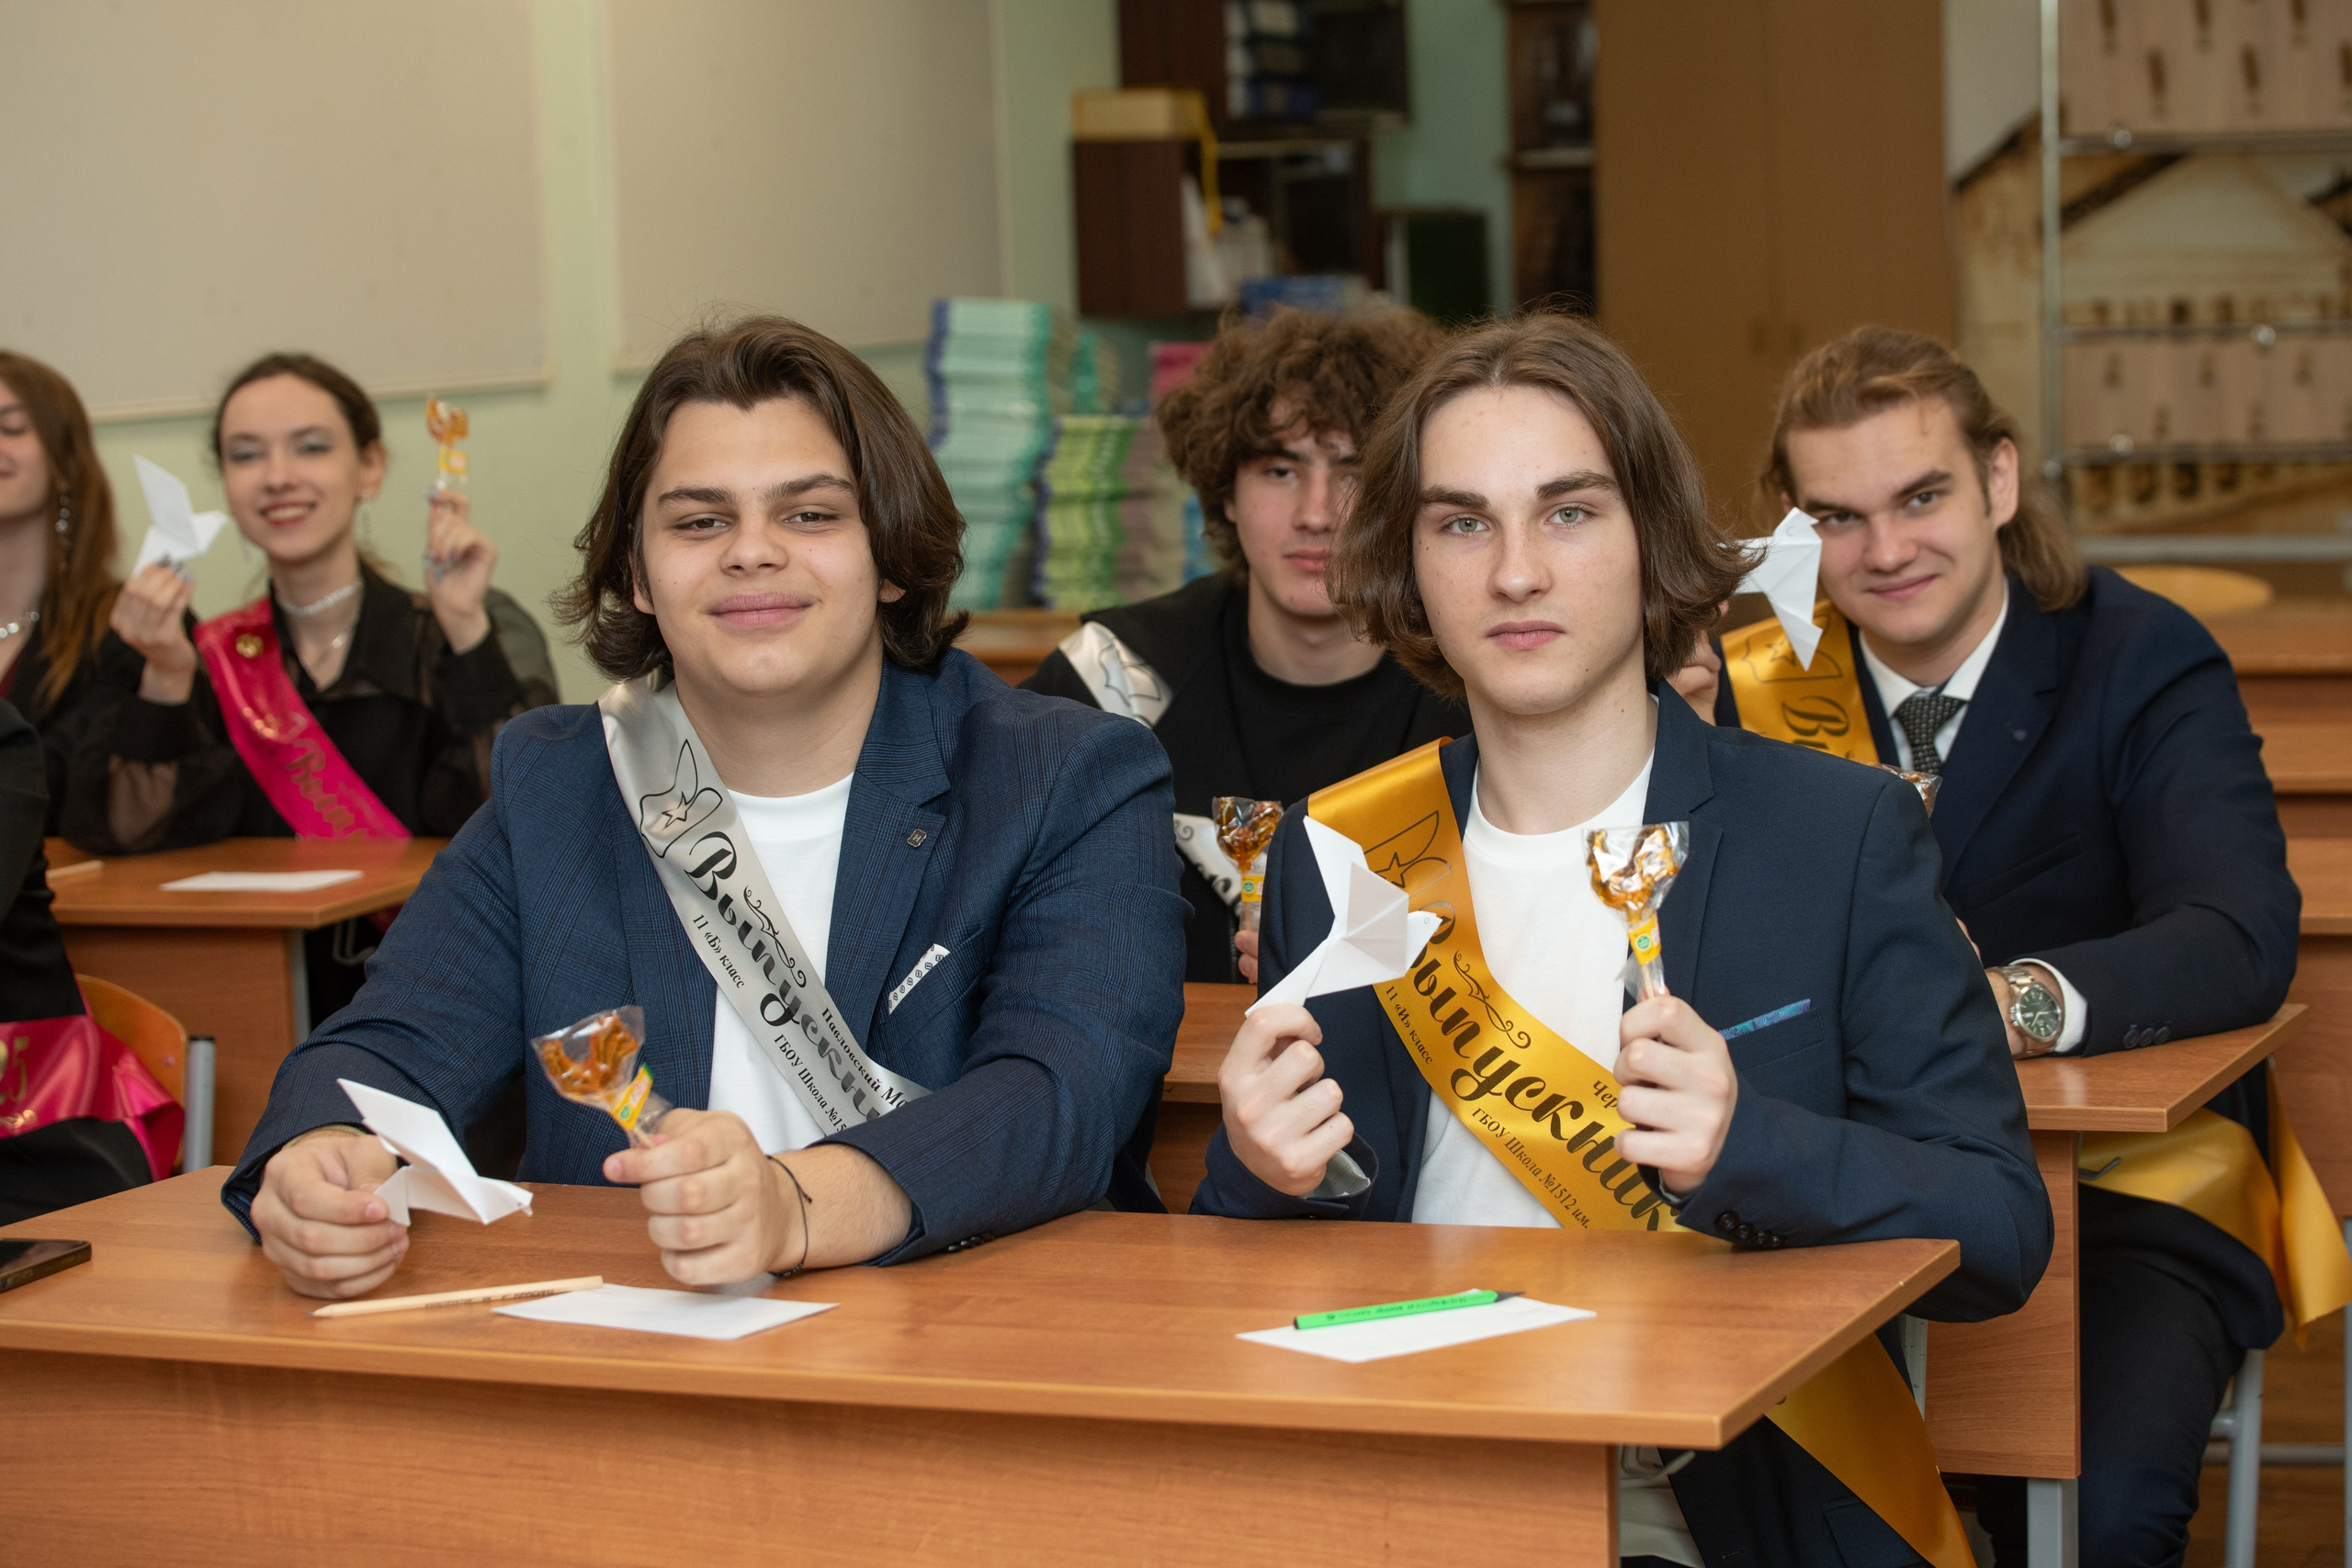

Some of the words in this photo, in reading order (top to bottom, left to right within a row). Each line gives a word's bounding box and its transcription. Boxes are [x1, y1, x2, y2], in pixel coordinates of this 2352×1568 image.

[684, 831, 880, 1122] Выпускн
[693, 914, 705, 931] 11
[704, 931, 722, 953] «Б»
[719, 954, 745, 988] класс
[822, 1008, 883, 1092] Павловский
[1385, 986, 1398, 1002] 11
[1395, 1003, 1410, 1028] «И»
[1409, 1030, 1433, 1065] класс
[774, 1033, 804, 1067] ГБОУ
[797, 1067, 828, 1109] Школа
[1472, 1107, 1510, 1139] ГБОУ
[1504, 1137, 1544, 1177] Школа
[1539, 1172, 1578, 1211] №1512
[1571, 1209, 1590, 1229] им.
